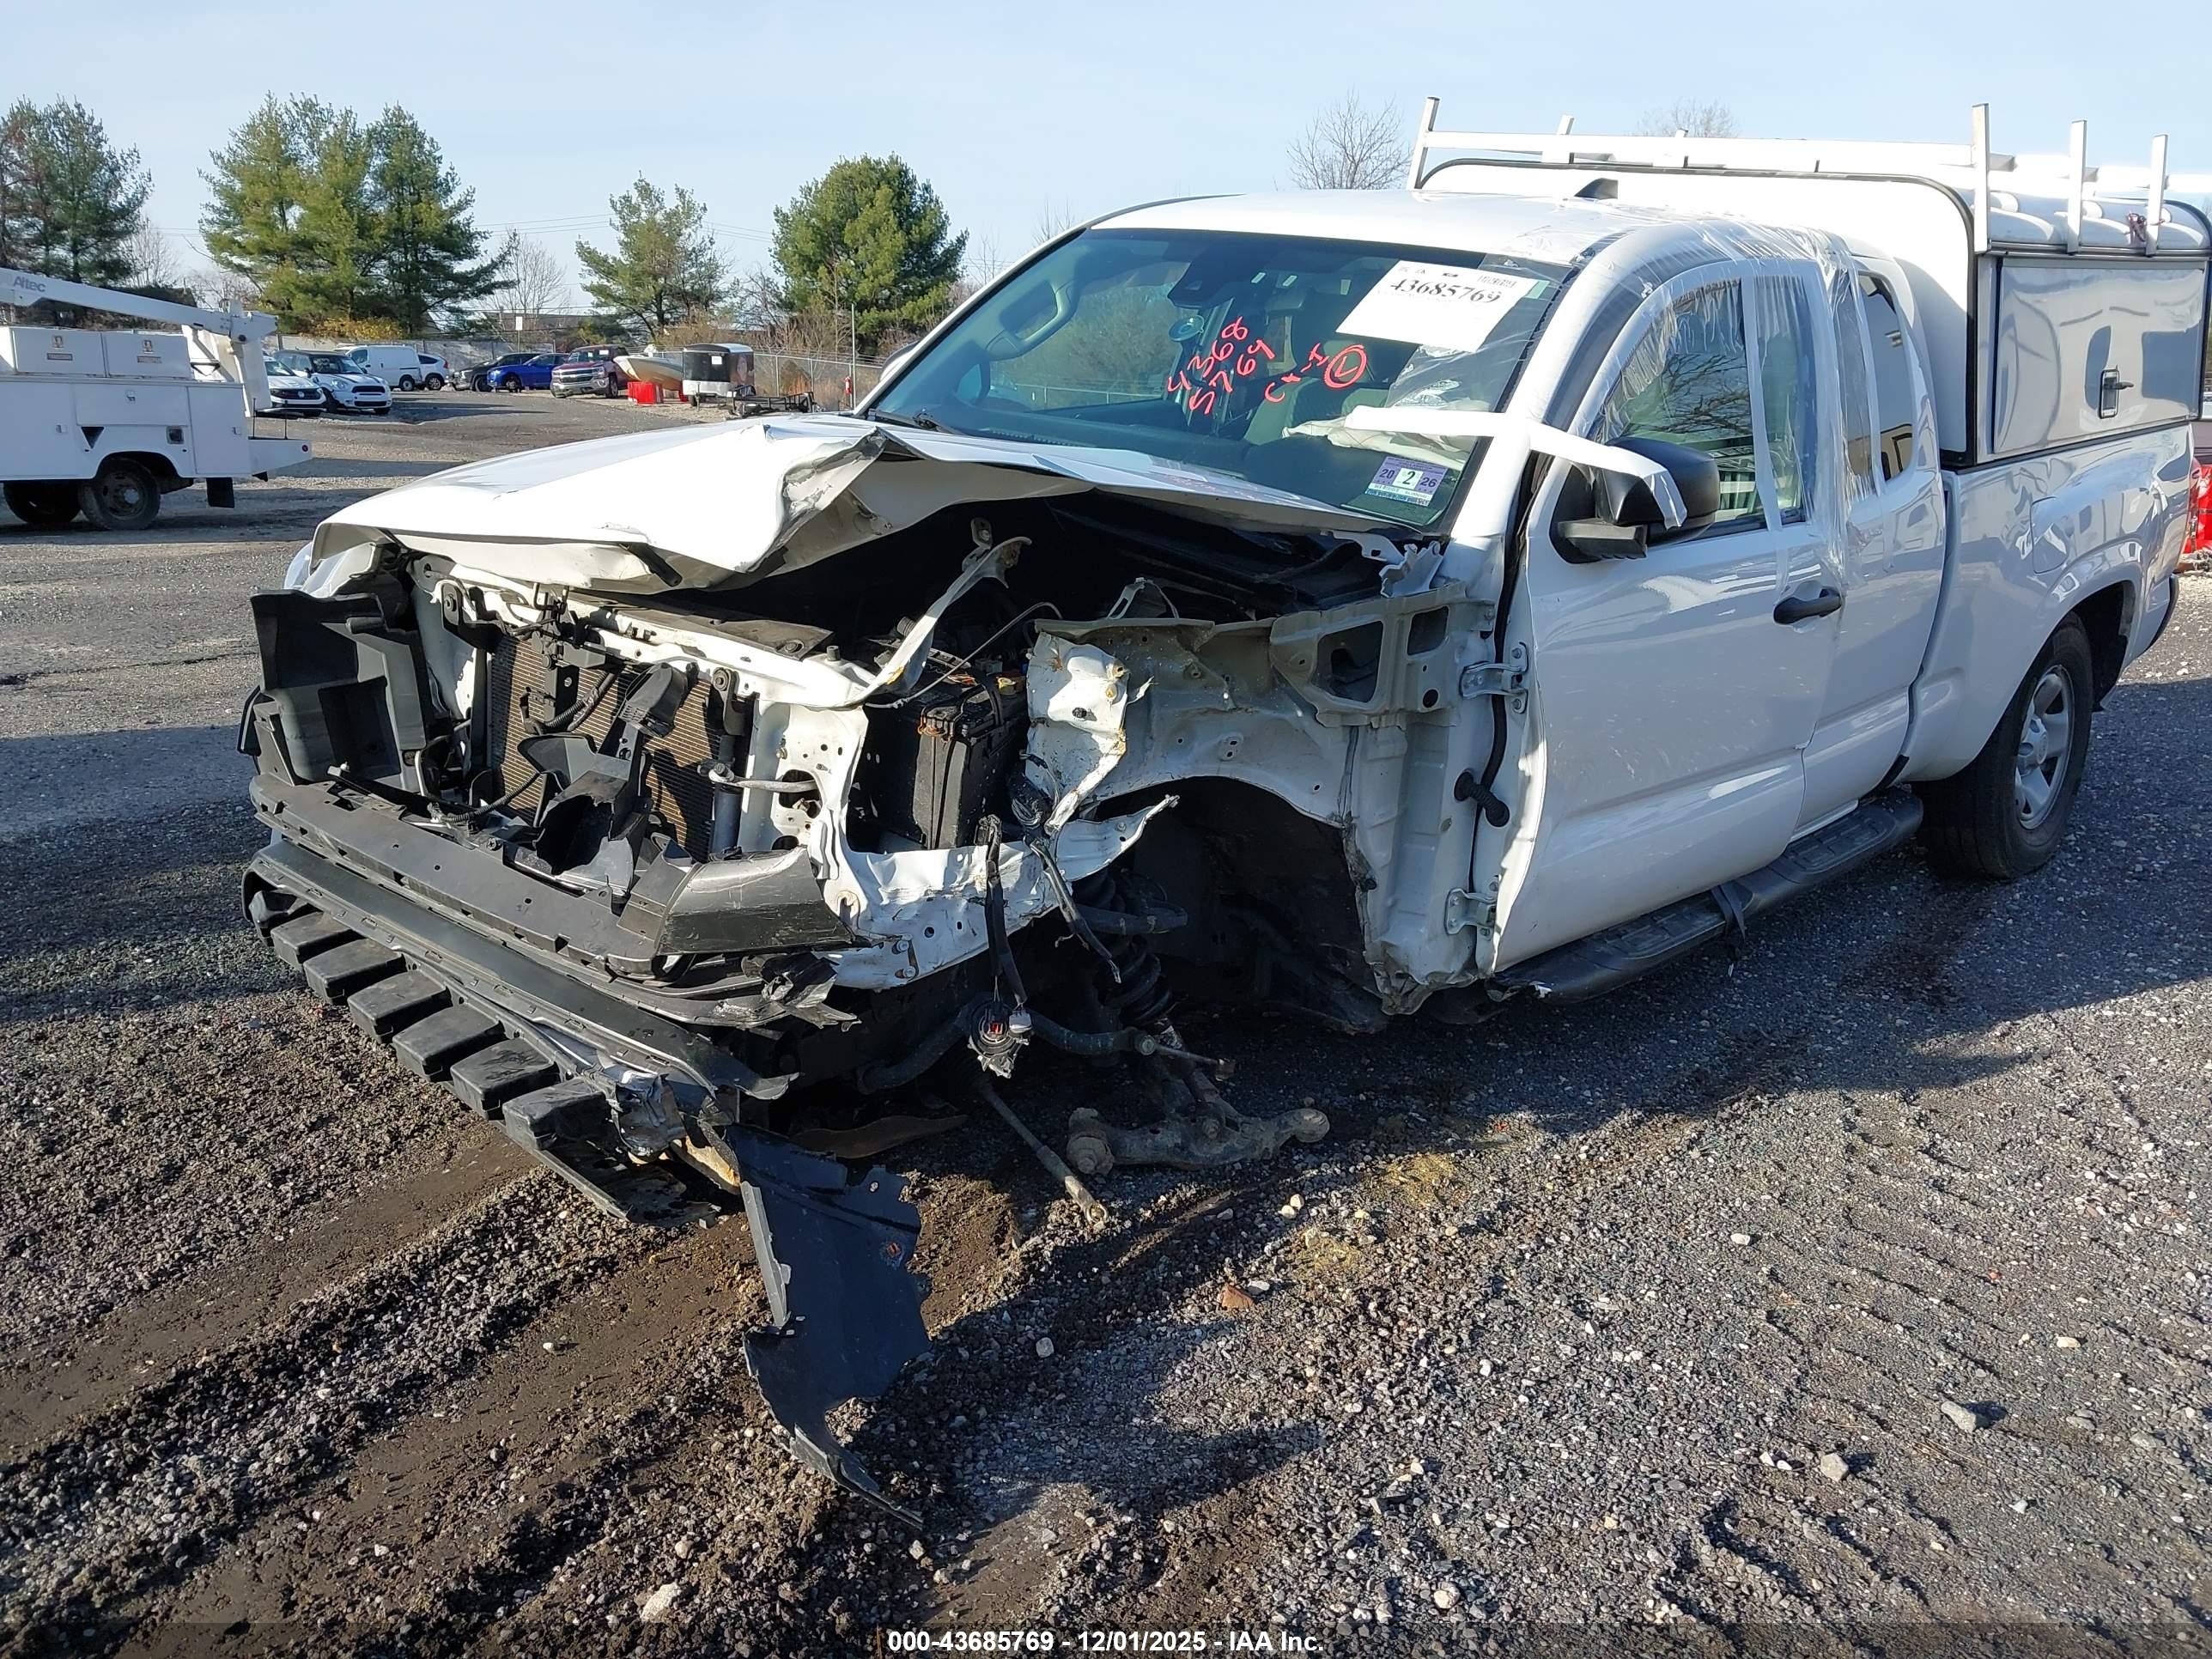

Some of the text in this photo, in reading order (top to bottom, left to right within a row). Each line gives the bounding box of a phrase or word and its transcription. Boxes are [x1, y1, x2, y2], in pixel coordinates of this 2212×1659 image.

[13, 275, 46, 294] Altec
[1390, 278, 1502, 303] 43685769
[1167, 315, 1249, 392] 4368
[1188, 339, 1276, 415] 5769
[1379, 468, 1437, 488] 20 2 26
